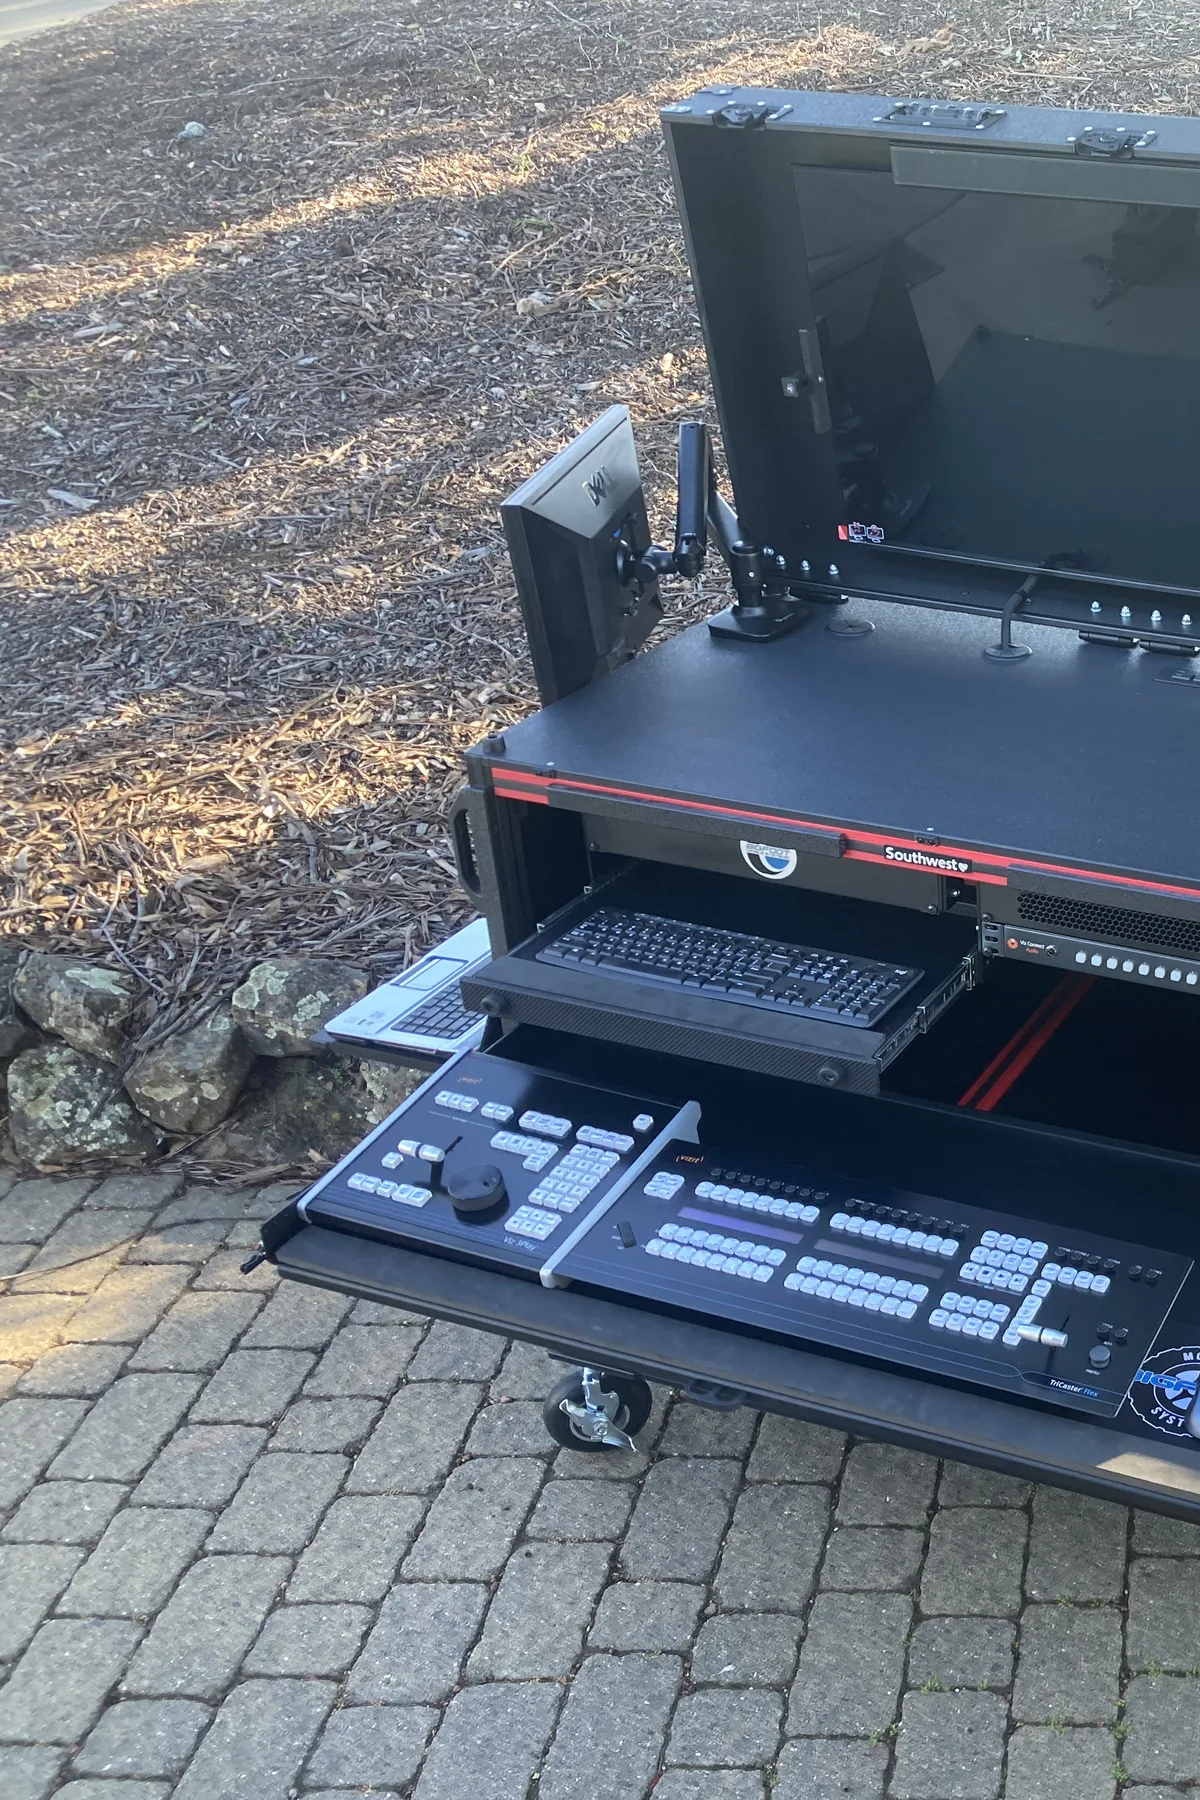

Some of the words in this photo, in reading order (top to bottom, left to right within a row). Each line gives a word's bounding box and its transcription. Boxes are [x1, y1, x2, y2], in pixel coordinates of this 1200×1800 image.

[885, 846, 958, 871] Southwest
[503, 1235, 516, 1245] Viz
[1050, 1379, 1083, 1393] TriCaster
[1083, 1387, 1100, 1398] Flex
[1151, 1406, 1185, 1428] SYST
